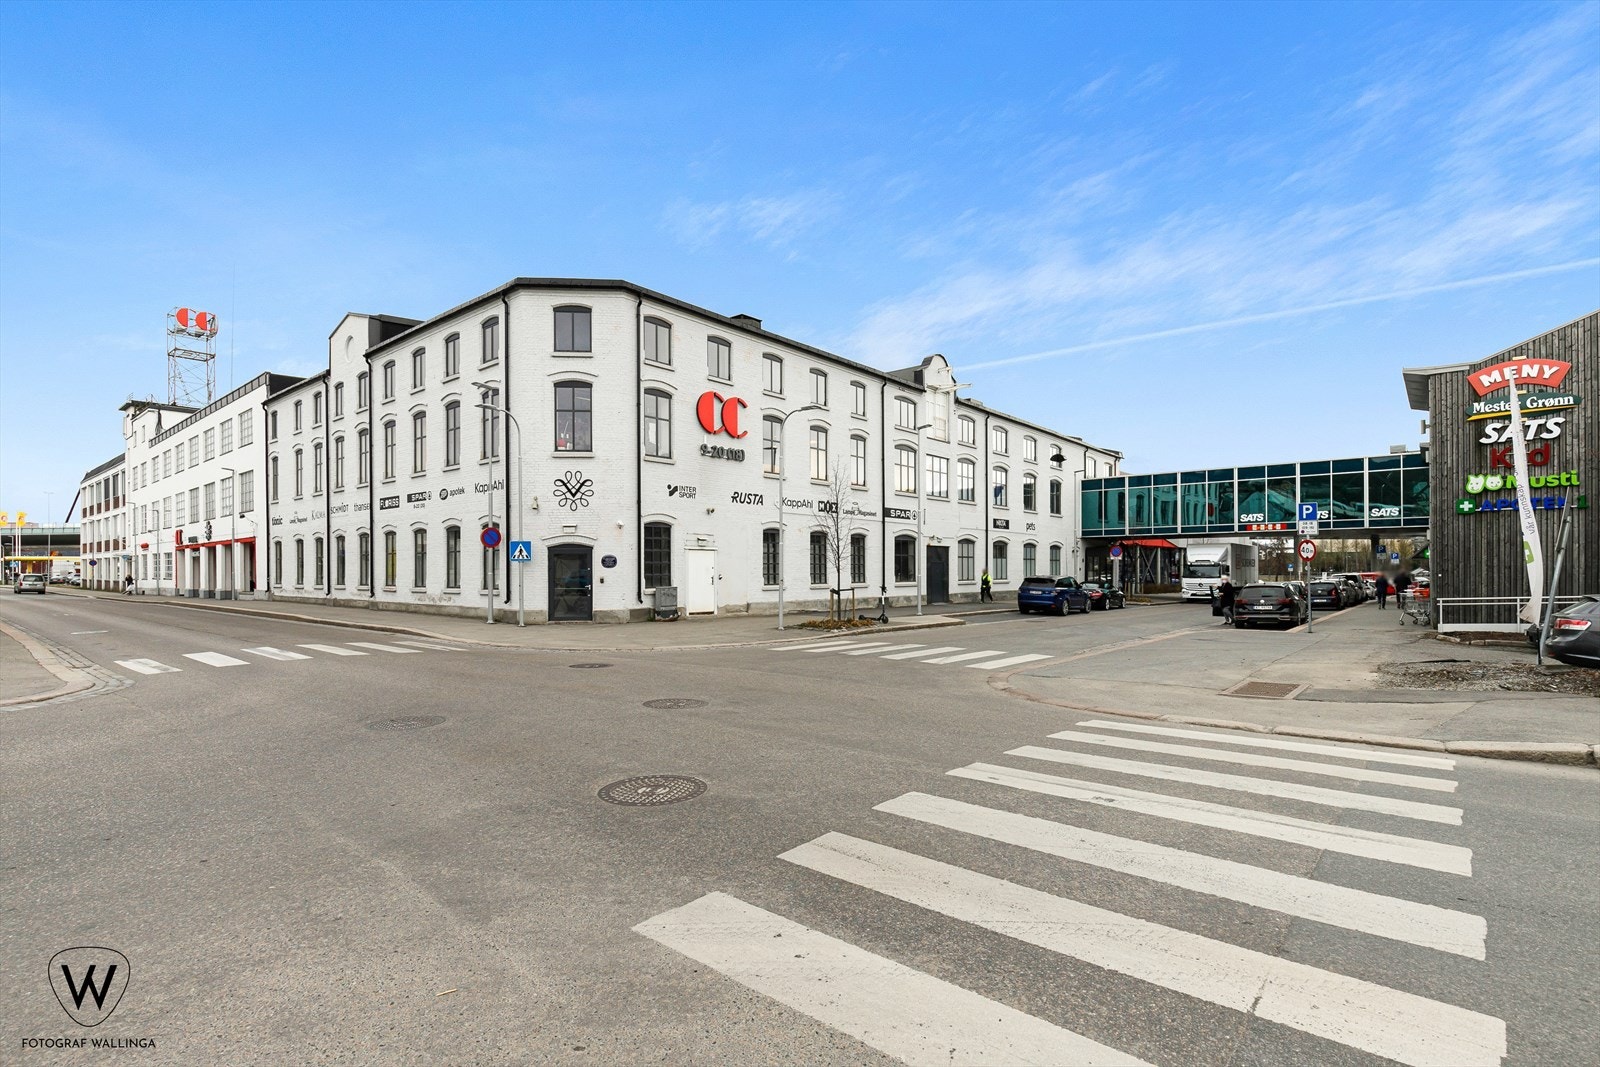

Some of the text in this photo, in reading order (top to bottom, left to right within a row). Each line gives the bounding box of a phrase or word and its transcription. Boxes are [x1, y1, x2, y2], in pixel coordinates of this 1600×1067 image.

[1479, 364, 1560, 387] MENY
[1526, 396, 1574, 408] Grønn
[1490, 443, 1550, 469] Kd
[679, 485, 697, 493] INTER
[679, 491, 697, 499] SPORT
[731, 491, 764, 506] RUSTA
[781, 497, 814, 509] KappAhl
[890, 509, 911, 519] SPAR
[1240, 513, 1264, 522] SATS
[1302, 505, 1313, 519] P
[1370, 507, 1400, 517] SATS
